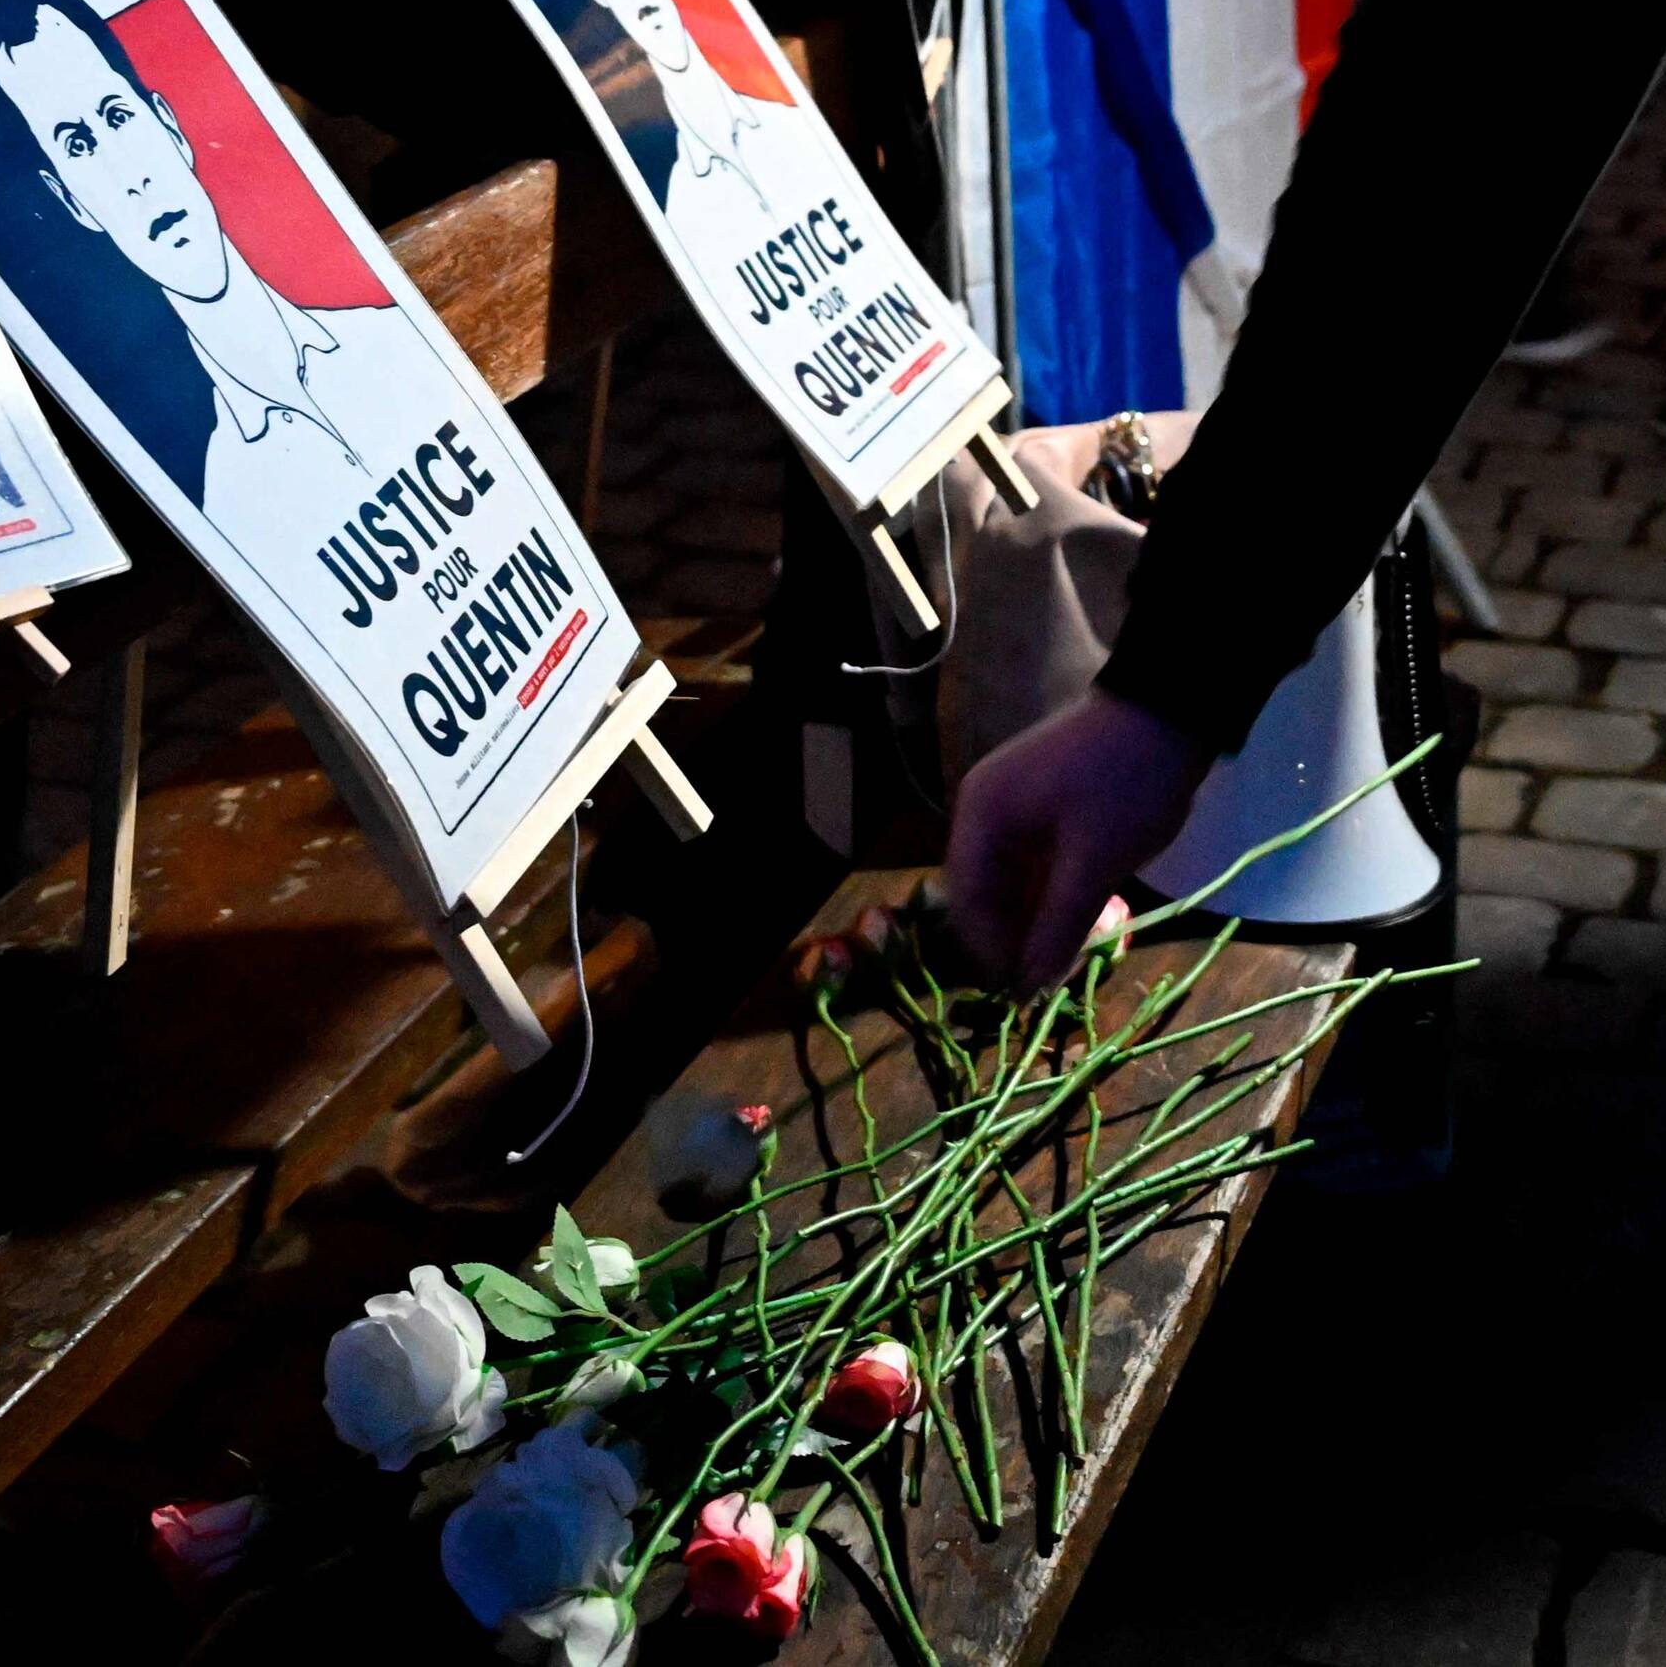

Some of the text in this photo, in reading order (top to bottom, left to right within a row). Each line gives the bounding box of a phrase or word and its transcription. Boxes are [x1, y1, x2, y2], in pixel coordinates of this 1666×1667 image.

[736, 197, 863, 326] JUSTICE
[808, 286, 850, 327] POUR
[794, 283, 932, 417] QUENTIN
[317, 420, 495, 628] JUSTICE
[422, 546, 480, 614] POUR
[401, 527, 574, 758] QUENTIN
